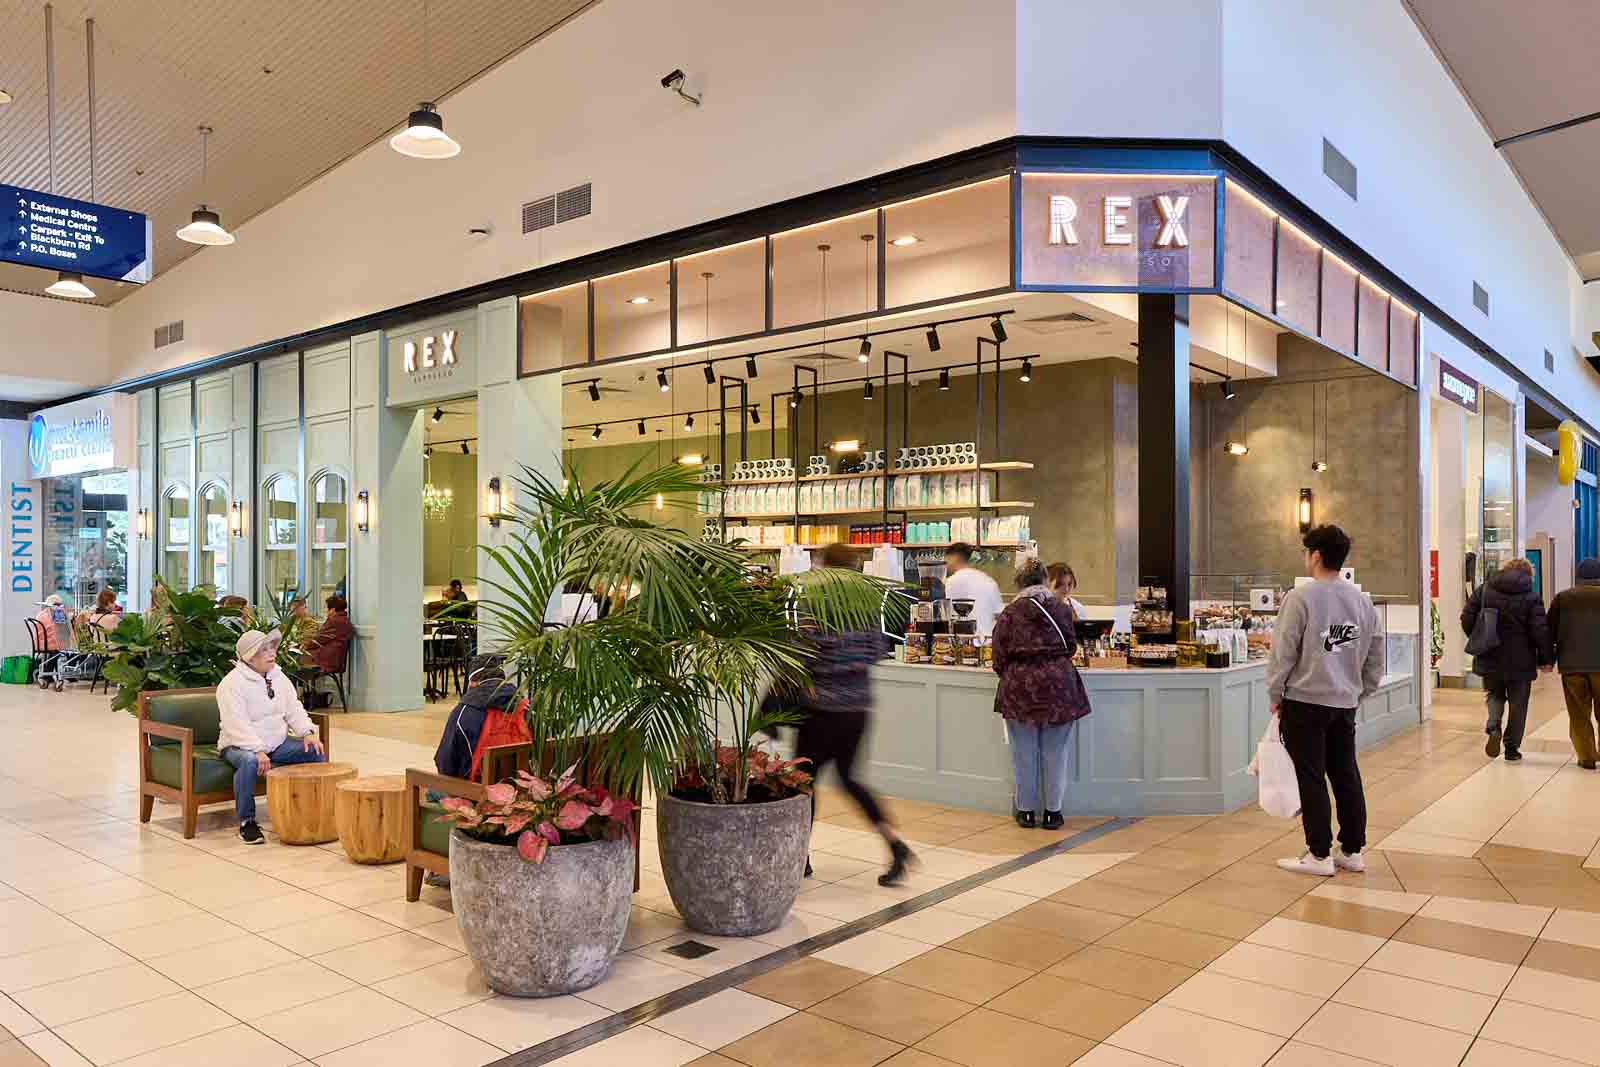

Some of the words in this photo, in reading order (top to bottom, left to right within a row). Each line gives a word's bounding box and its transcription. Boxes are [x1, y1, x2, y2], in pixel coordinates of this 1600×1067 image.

[30, 201, 69, 216] External
[70, 209, 98, 223] Shops
[30, 212, 66, 227] Medical
[67, 219, 97, 233] Centre
[1049, 194, 1190, 247] REX
[30, 223, 67, 238] Carpark
[74, 232, 93, 242] Exit
[94, 235, 105, 245] To
[30, 233, 77, 249] Blackburn
[78, 241, 91, 251] Rd
[30, 243, 48, 254] P.O.
[49, 246, 77, 259] Boxes
[404, 330, 456, 372] REX
[11, 482, 33, 593] DENTIST
[1329, 624, 1355, 640] NIKE
